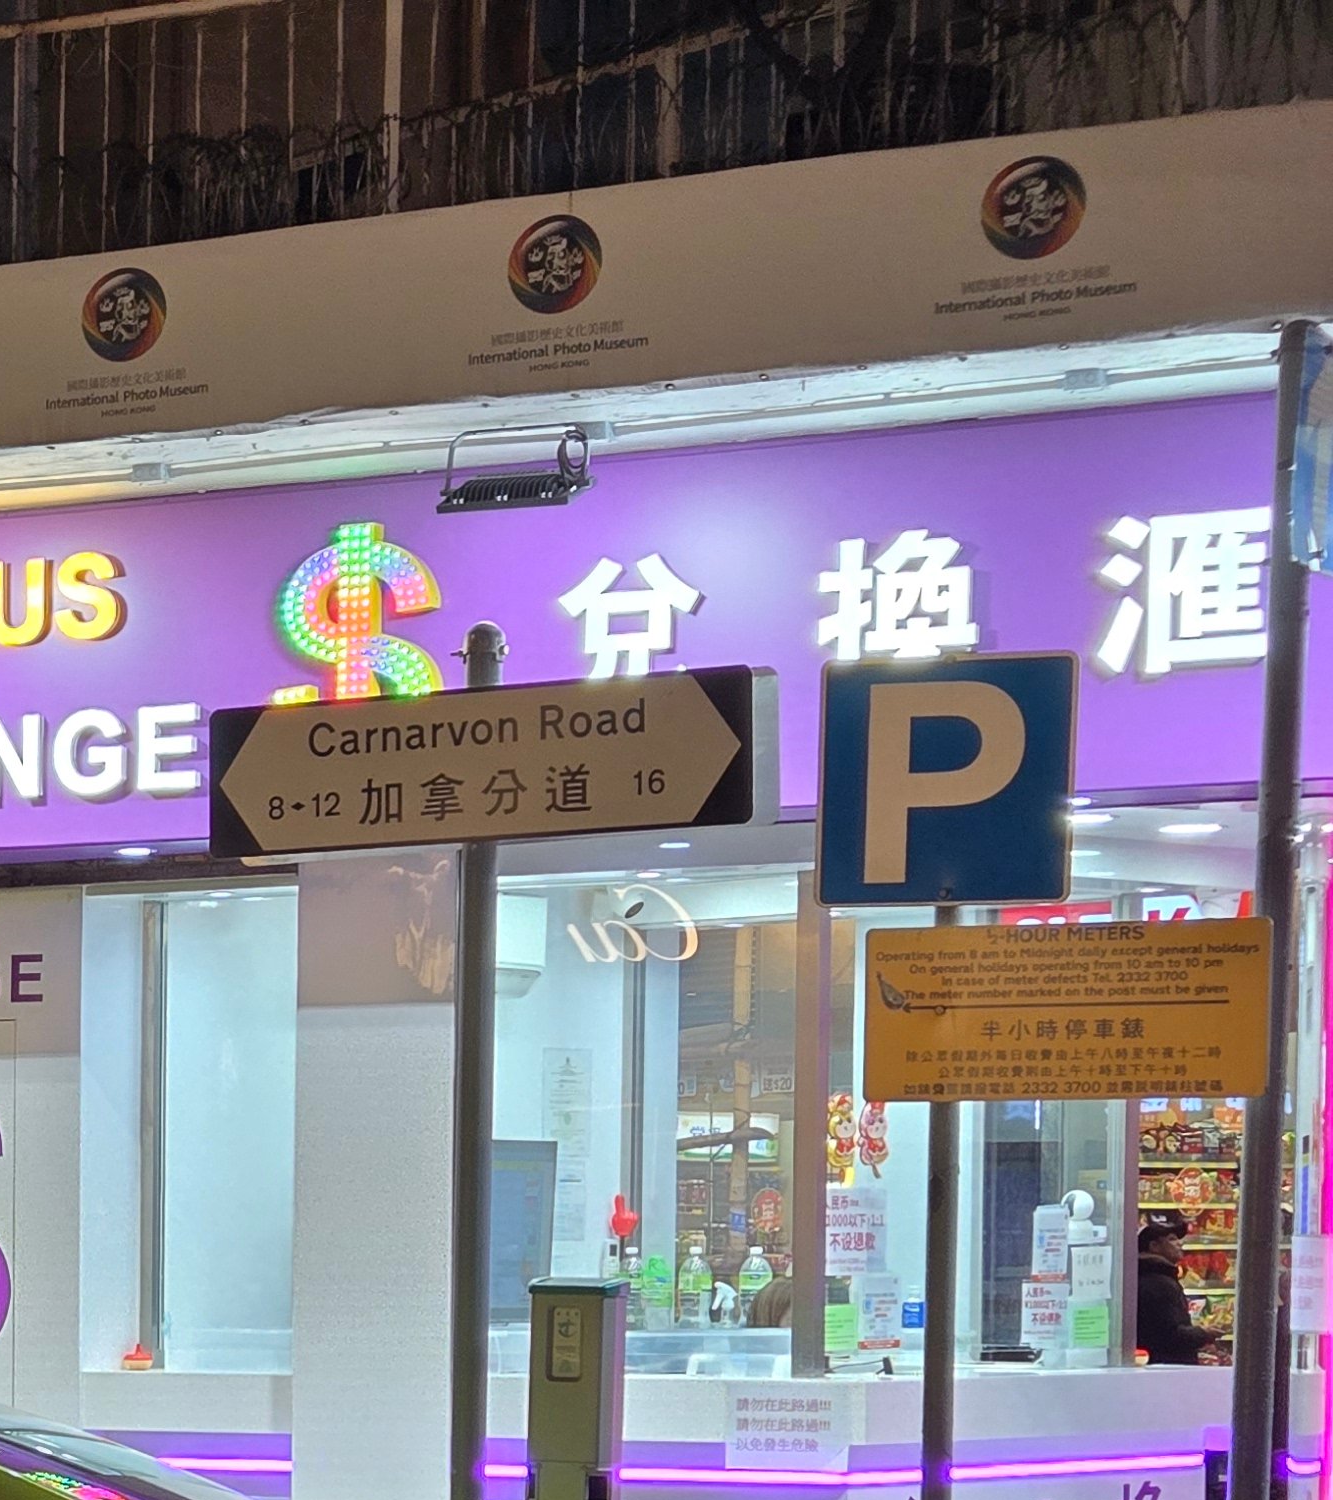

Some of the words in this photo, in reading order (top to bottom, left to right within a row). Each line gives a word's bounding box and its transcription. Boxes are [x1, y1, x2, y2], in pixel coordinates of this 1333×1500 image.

[934, 291, 1026, 314] International
[1031, 288, 1073, 304] Photo
[1075, 282, 1137, 299] Museum
[468, 345, 549, 366] International
[554, 341, 591, 356] Photo
[593, 336, 649, 352] Museum
[45, 392, 119, 410] International
[123, 388, 158, 402] Photo
[159, 382, 209, 399] Museum
[307, 713, 520, 758] Carnarvon
[539, 698, 647, 741] Road
[358, 763, 593, 826] 加拿分道
[633, 769, 666, 796] 16
[862, 680, 1027, 885] P
[1067, 925, 1145, 942] METERS
[876, 950, 935, 963] Operating
[938, 950, 966, 961] from
[981, 951, 1000, 960] am
[1004, 950, 1017, 960] to
[1020, 947, 1074, 961] Midnight
[1078, 946, 1107, 958] daily
[1112, 945, 1153, 957] except
[1157, 944, 1203, 956] general
[1207, 943, 1260, 956] holidays
[909, 963, 927, 975] On
[930, 963, 975, 976] general
[978, 962, 1029, 975] holidays
[1032, 961, 1090, 974] operating
[1093, 959, 1123, 970] from
[1127, 959, 1141, 970] 10
[1144, 960, 1164, 969] am
[1168, 959, 1182, 968] to
[1186, 957, 1200, 968] 10
[1204, 959, 1224, 970] pm
[942, 976, 953, 986] In
[956, 977, 986, 986] case
[988, 975, 1001, 985] of
[1004, 975, 1041, 985] meter
[1043, 972, 1088, 984] defects
[1117, 971, 1150, 983] 2332
[1155, 970, 1189, 982] 3700
[903, 990, 927, 1001] The
[933, 990, 963, 1000] meter
[967, 989, 1012, 999] number
[1015, 987, 1062, 998] marked
[1065, 988, 1081, 997] on
[1084, 986, 1104, 996] the
[1108, 986, 1136, 998] post
[1140, 985, 1171, 995] must
[1175, 984, 1191, 994] be
[1195, 984, 1229, 996] given
[981, 1017, 1145, 1042] 半小時停車錶
[1021, 1082, 1059, 1095] 2332
[1064, 1080, 1102, 1094] 3700
